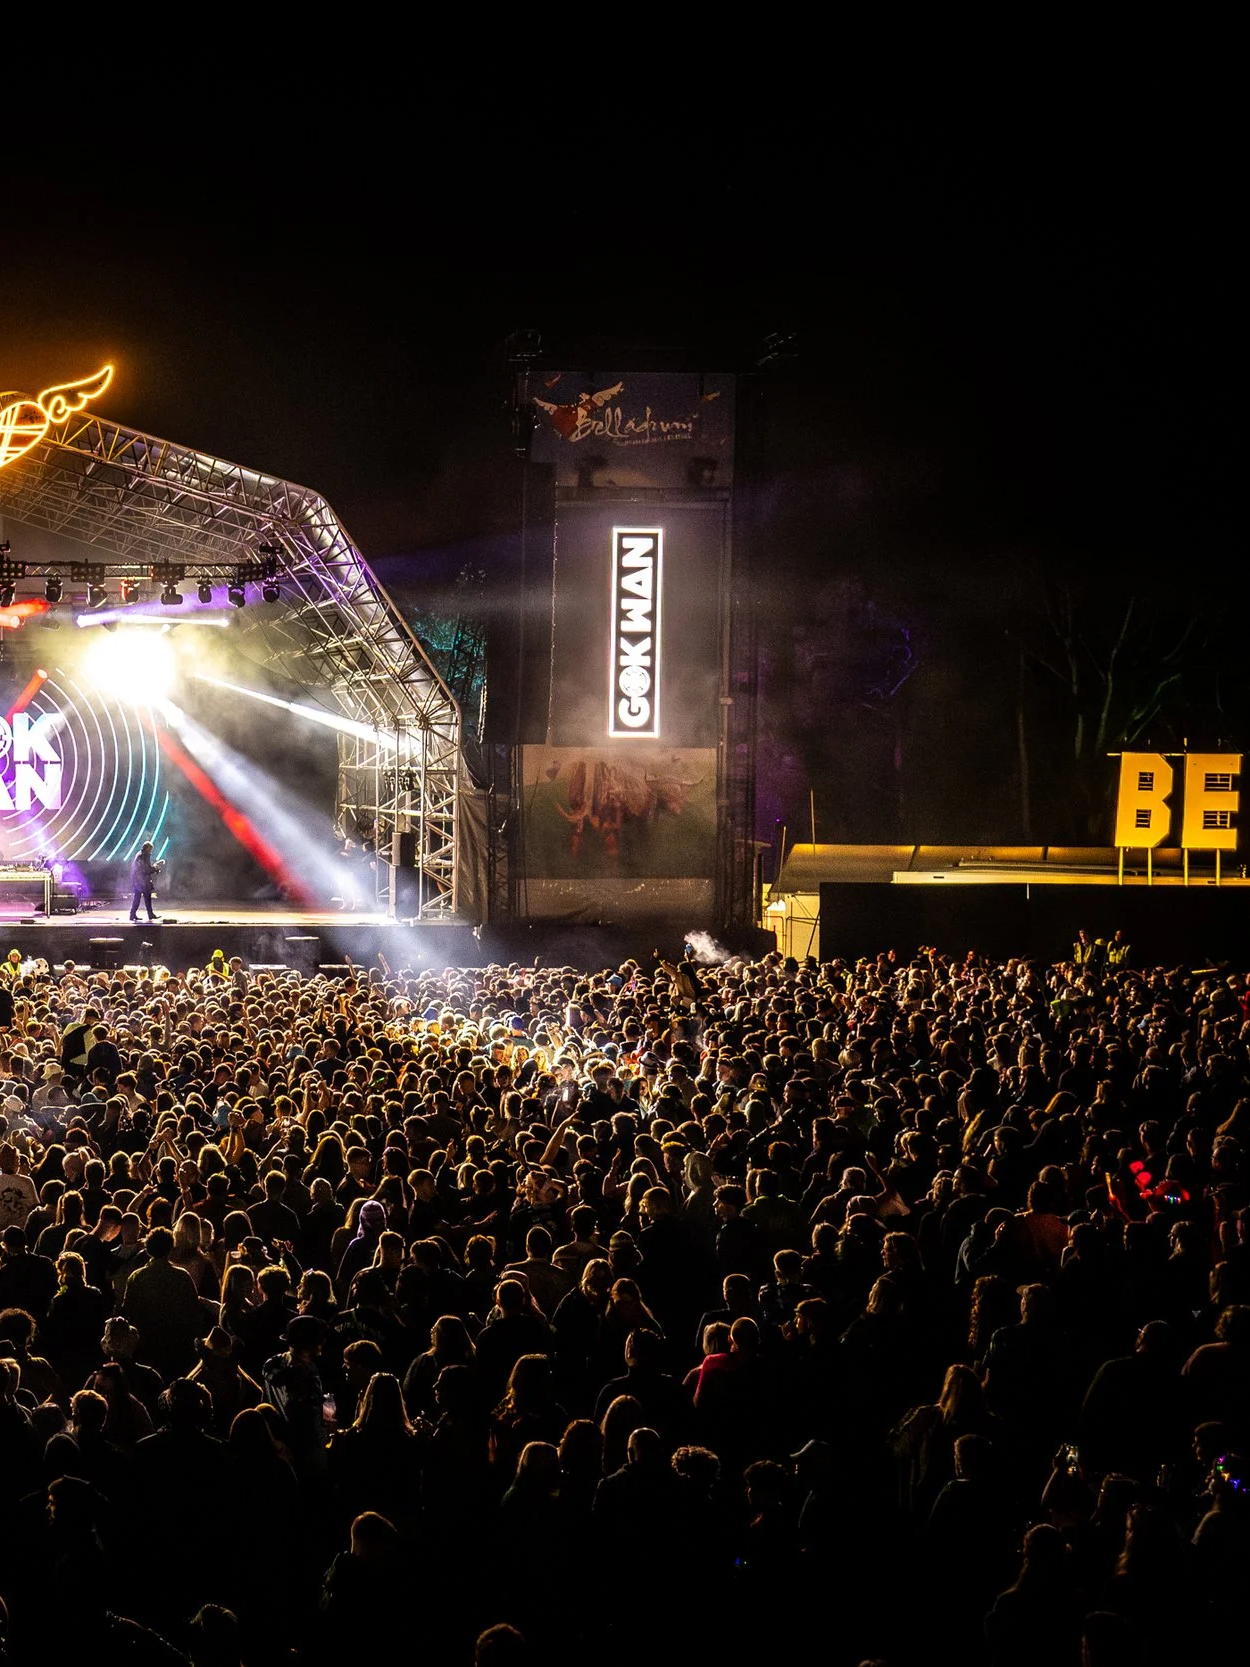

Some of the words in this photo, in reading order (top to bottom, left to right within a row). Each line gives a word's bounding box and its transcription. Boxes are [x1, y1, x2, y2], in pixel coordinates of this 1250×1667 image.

[620, 537, 654, 632] WAN
[618, 636, 651, 728] GOK
[1114, 752, 1242, 849] BE
